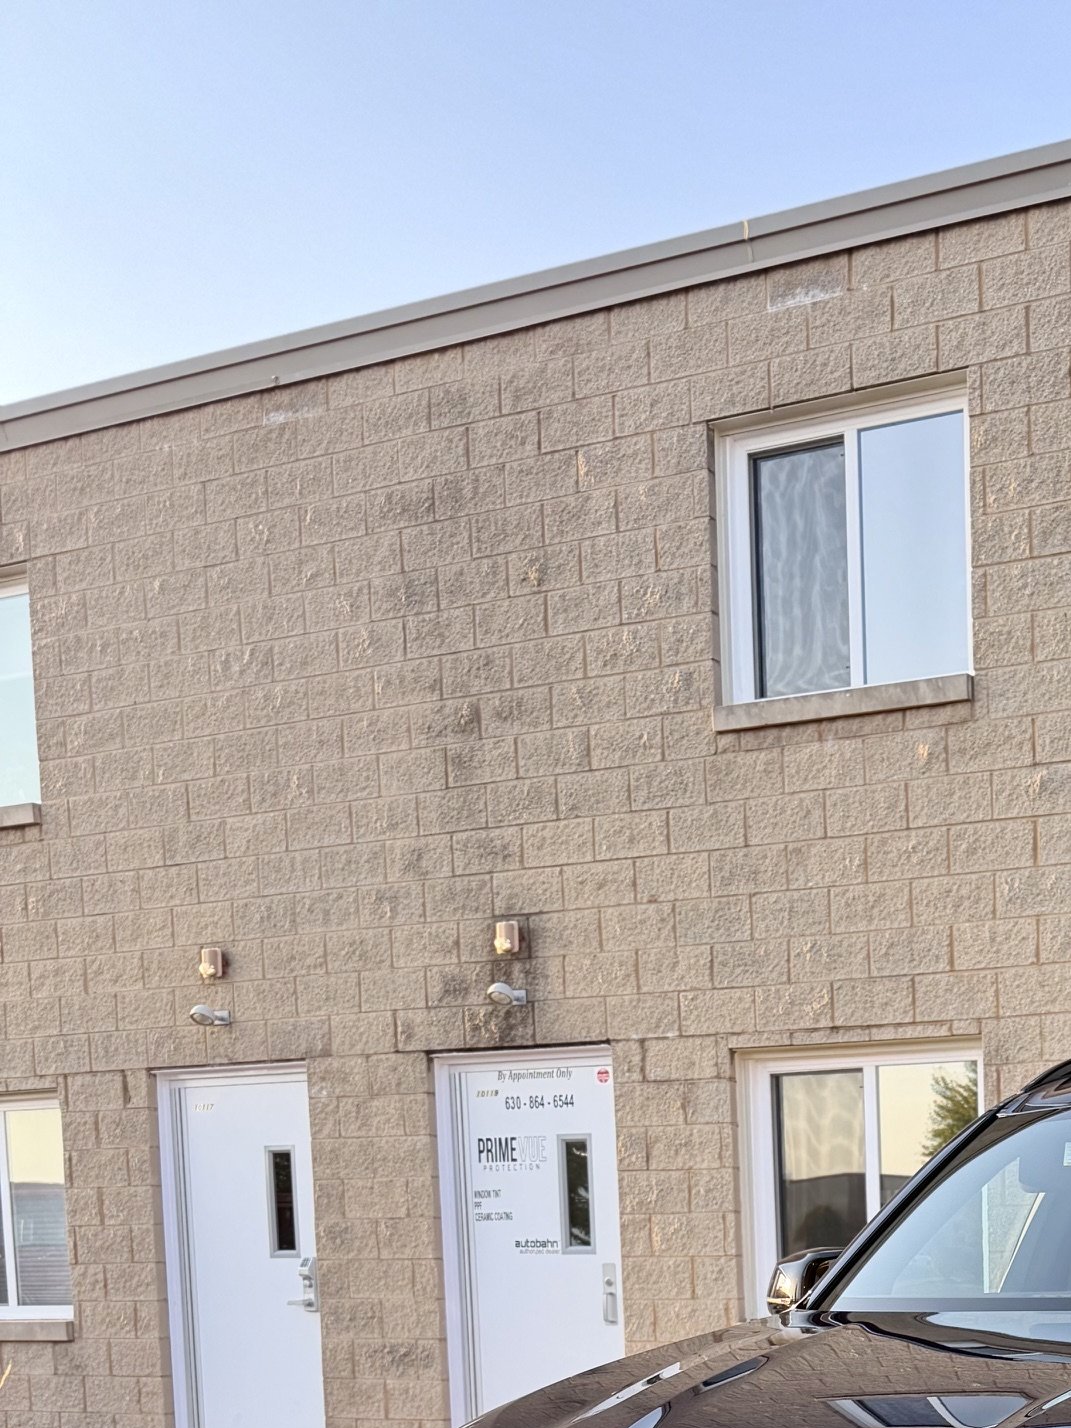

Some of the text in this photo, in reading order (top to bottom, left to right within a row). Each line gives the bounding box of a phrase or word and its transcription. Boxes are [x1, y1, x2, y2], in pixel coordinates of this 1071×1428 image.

[497, 1067, 573, 1083] By Appointment Only
[505, 1096, 522, 1110] 630
[529, 1095, 545, 1109] 864
[553, 1094, 575, 1108] 6544
[484, 1163, 541, 1172] PROTECTION
[514, 1238, 559, 1249] autobahn
